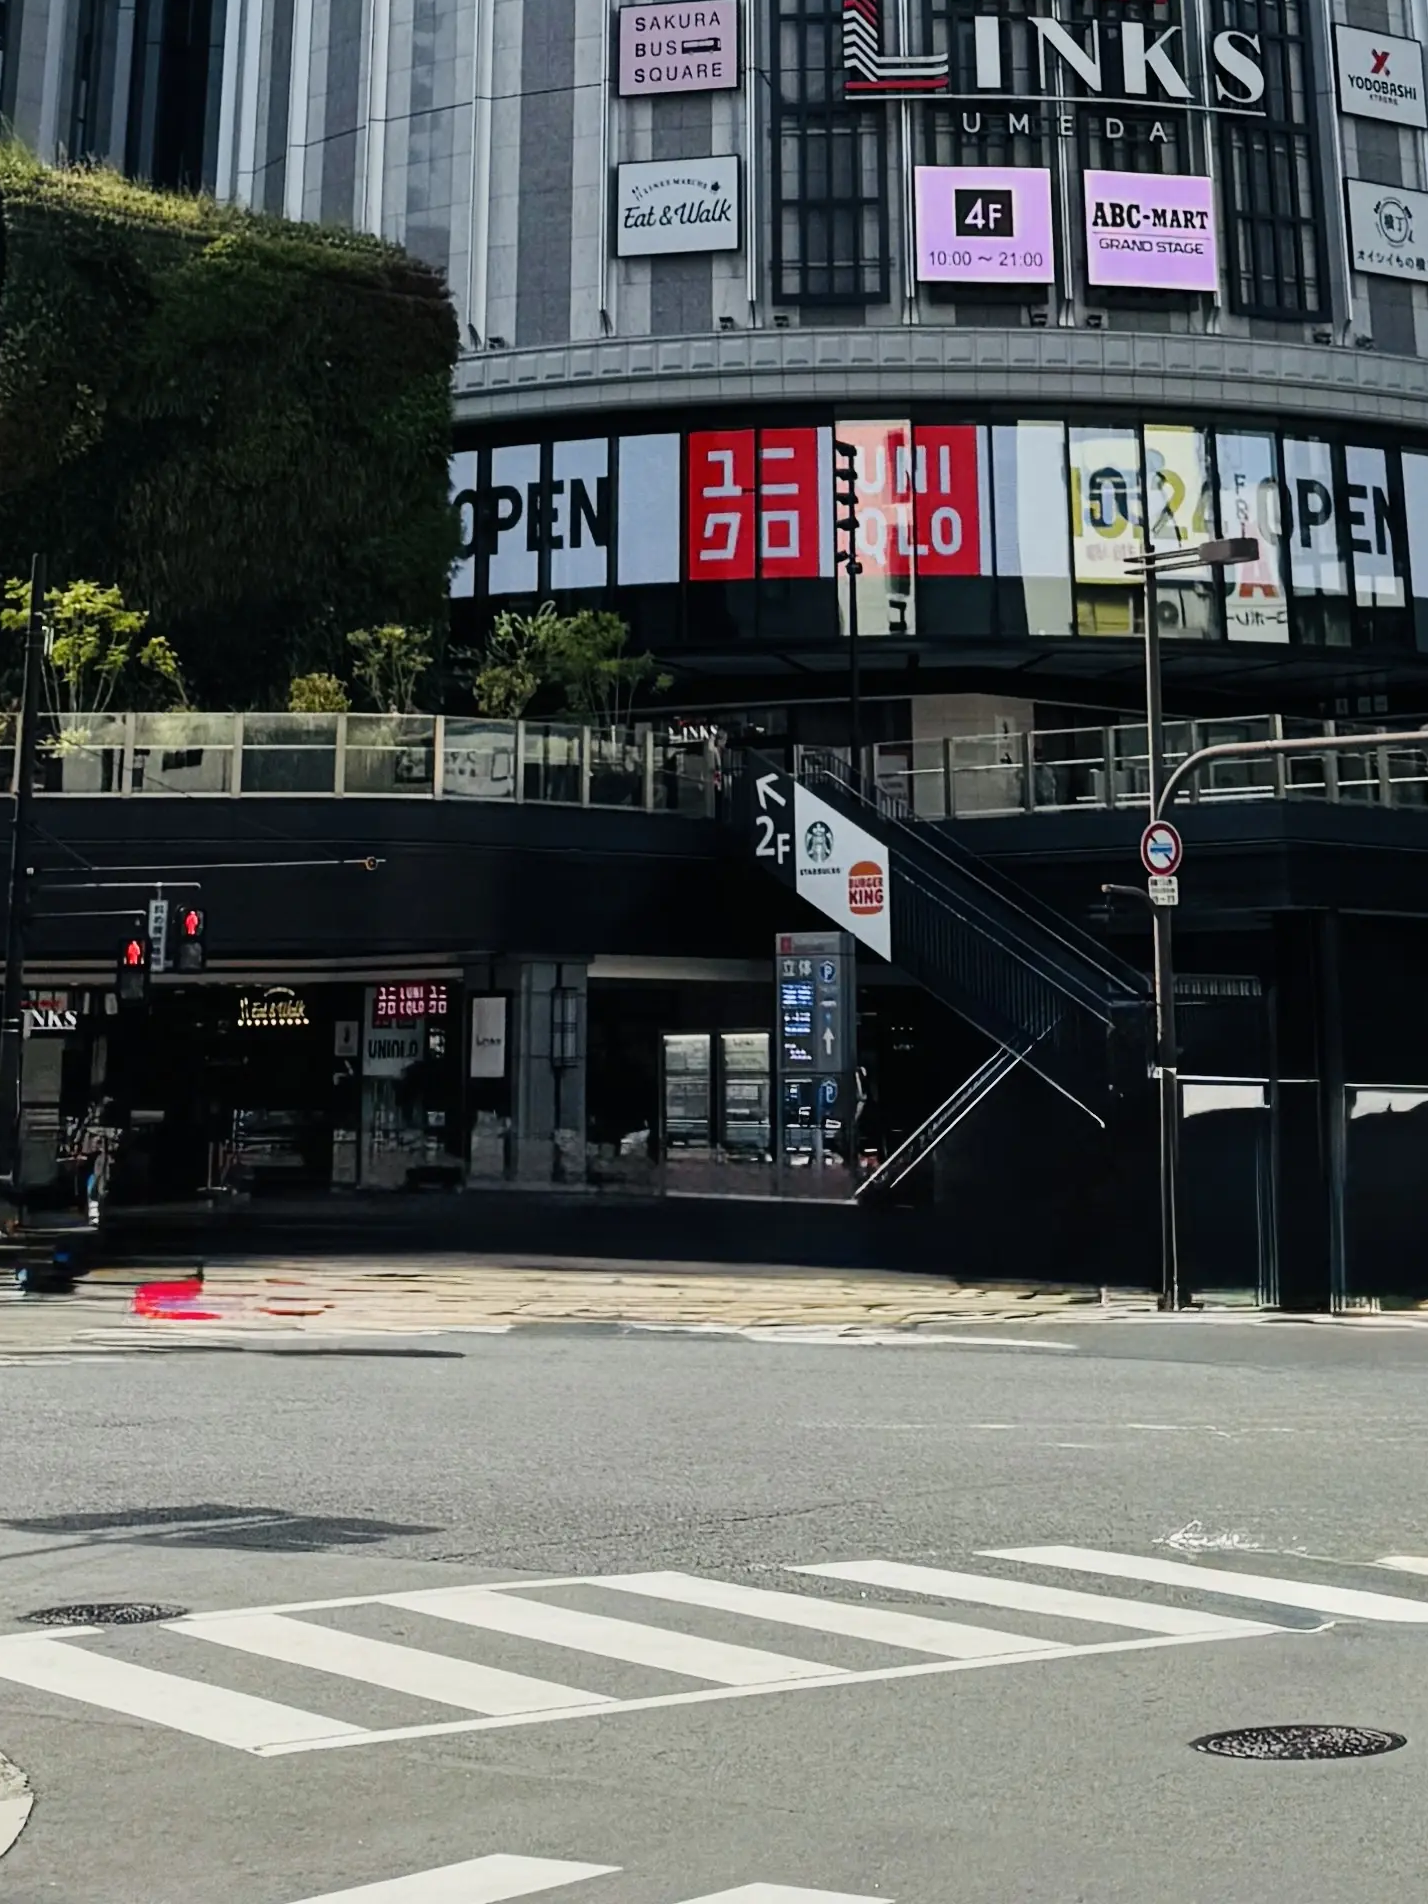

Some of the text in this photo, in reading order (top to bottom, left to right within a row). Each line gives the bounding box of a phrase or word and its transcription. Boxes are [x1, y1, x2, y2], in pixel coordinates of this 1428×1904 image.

[634, 10, 722, 33] SAKURA
[635, 39, 678, 59] BUS
[633, 61, 724, 85] SQUARE
[1347, 73, 1418, 101] YODOBASHI
[962, 111, 1169, 143] UMEDA
[623, 197, 732, 229] Eat & Walk
[964, 196, 1002, 230] 4F
[1091, 200, 1210, 232] ABC-MART
[928, 249, 973, 267] 10:00
[999, 251, 1044, 268] 21:00
[1099, 238, 1205, 256] GRAND STAGE
[702, 446, 800, 498] ユニ
[854, 444, 952, 495] UNI
[445, 475, 609, 560] OPEN
[1256, 476, 1396, 556] OPEN
[699, 510, 800, 561] クロ
[854, 505, 963, 569] QLO
[755, 814, 791, 865] 2F
[848, 876, 884, 889] BURGER
[848, 888, 885, 905] KING
